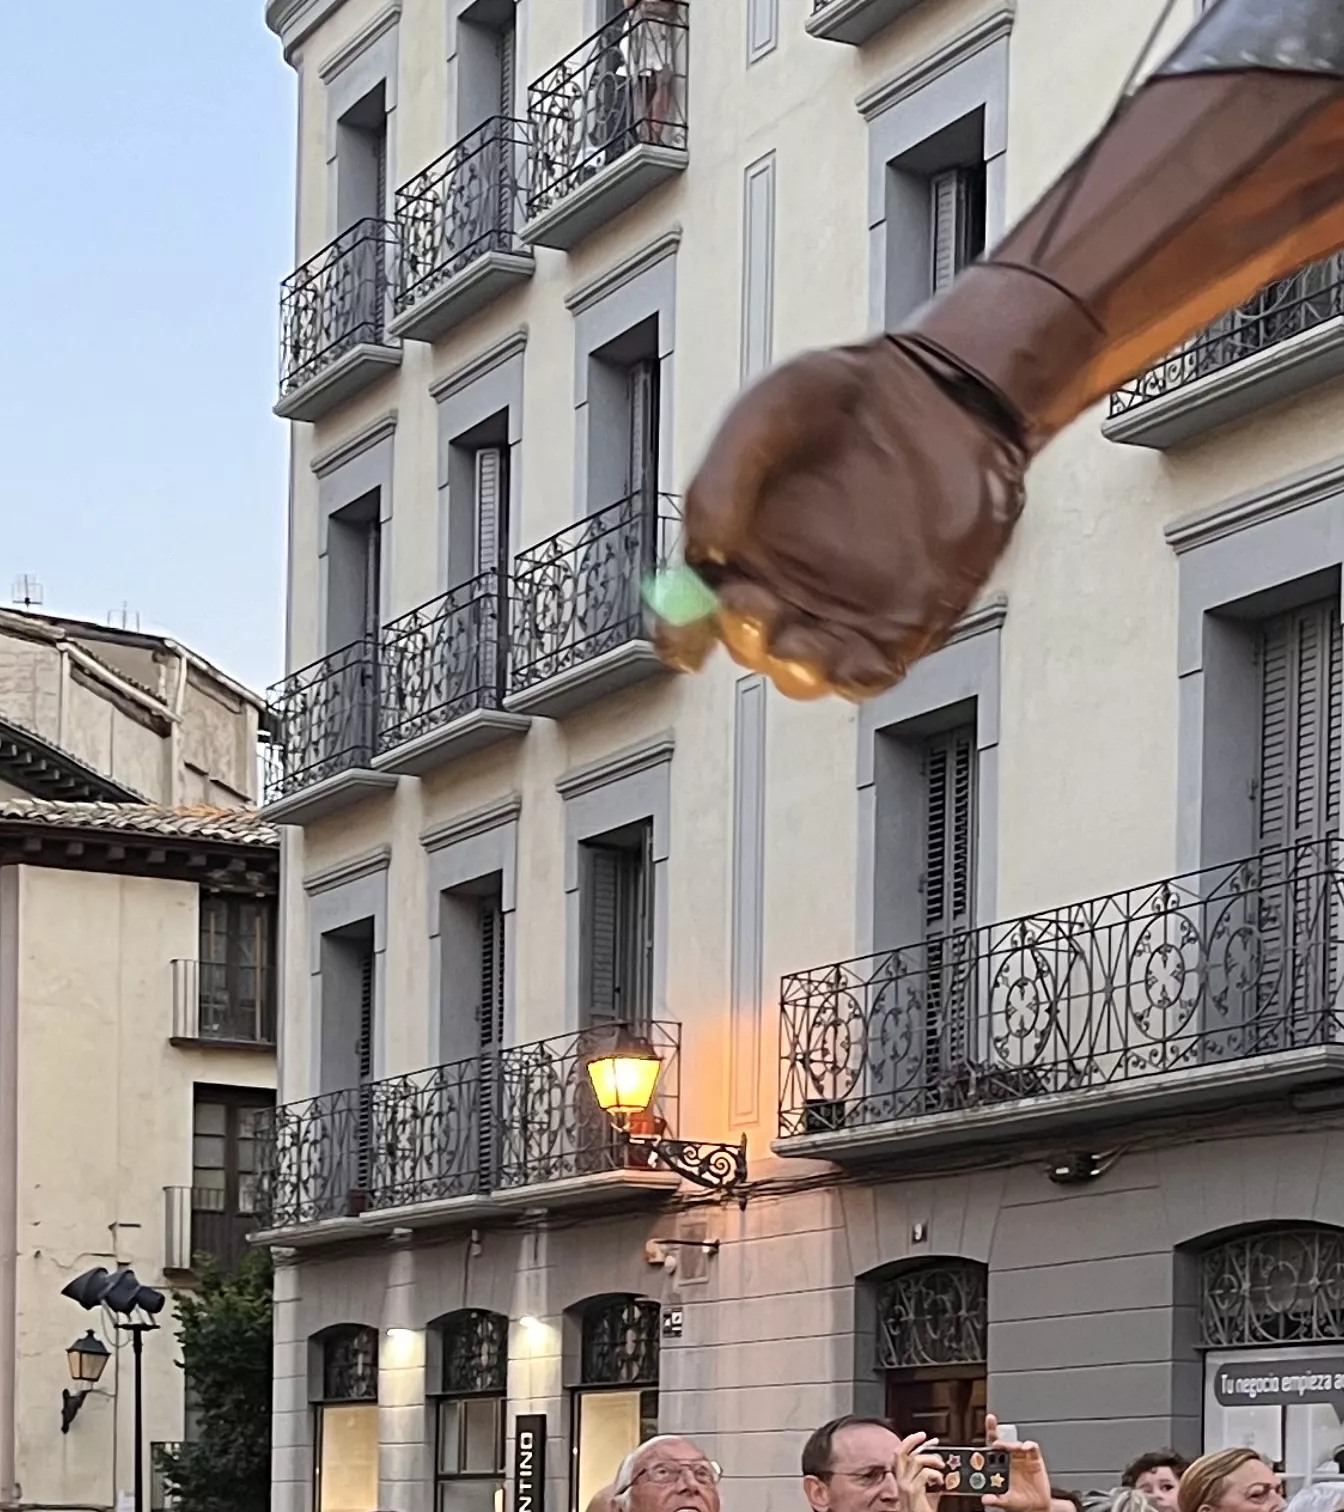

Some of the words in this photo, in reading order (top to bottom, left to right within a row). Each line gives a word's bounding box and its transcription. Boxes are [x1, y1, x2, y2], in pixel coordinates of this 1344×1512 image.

[1221, 1373, 1235, 1395] Tu
[1236, 1371, 1280, 1399] negocio
[1281, 1369, 1332, 1397] empieza
